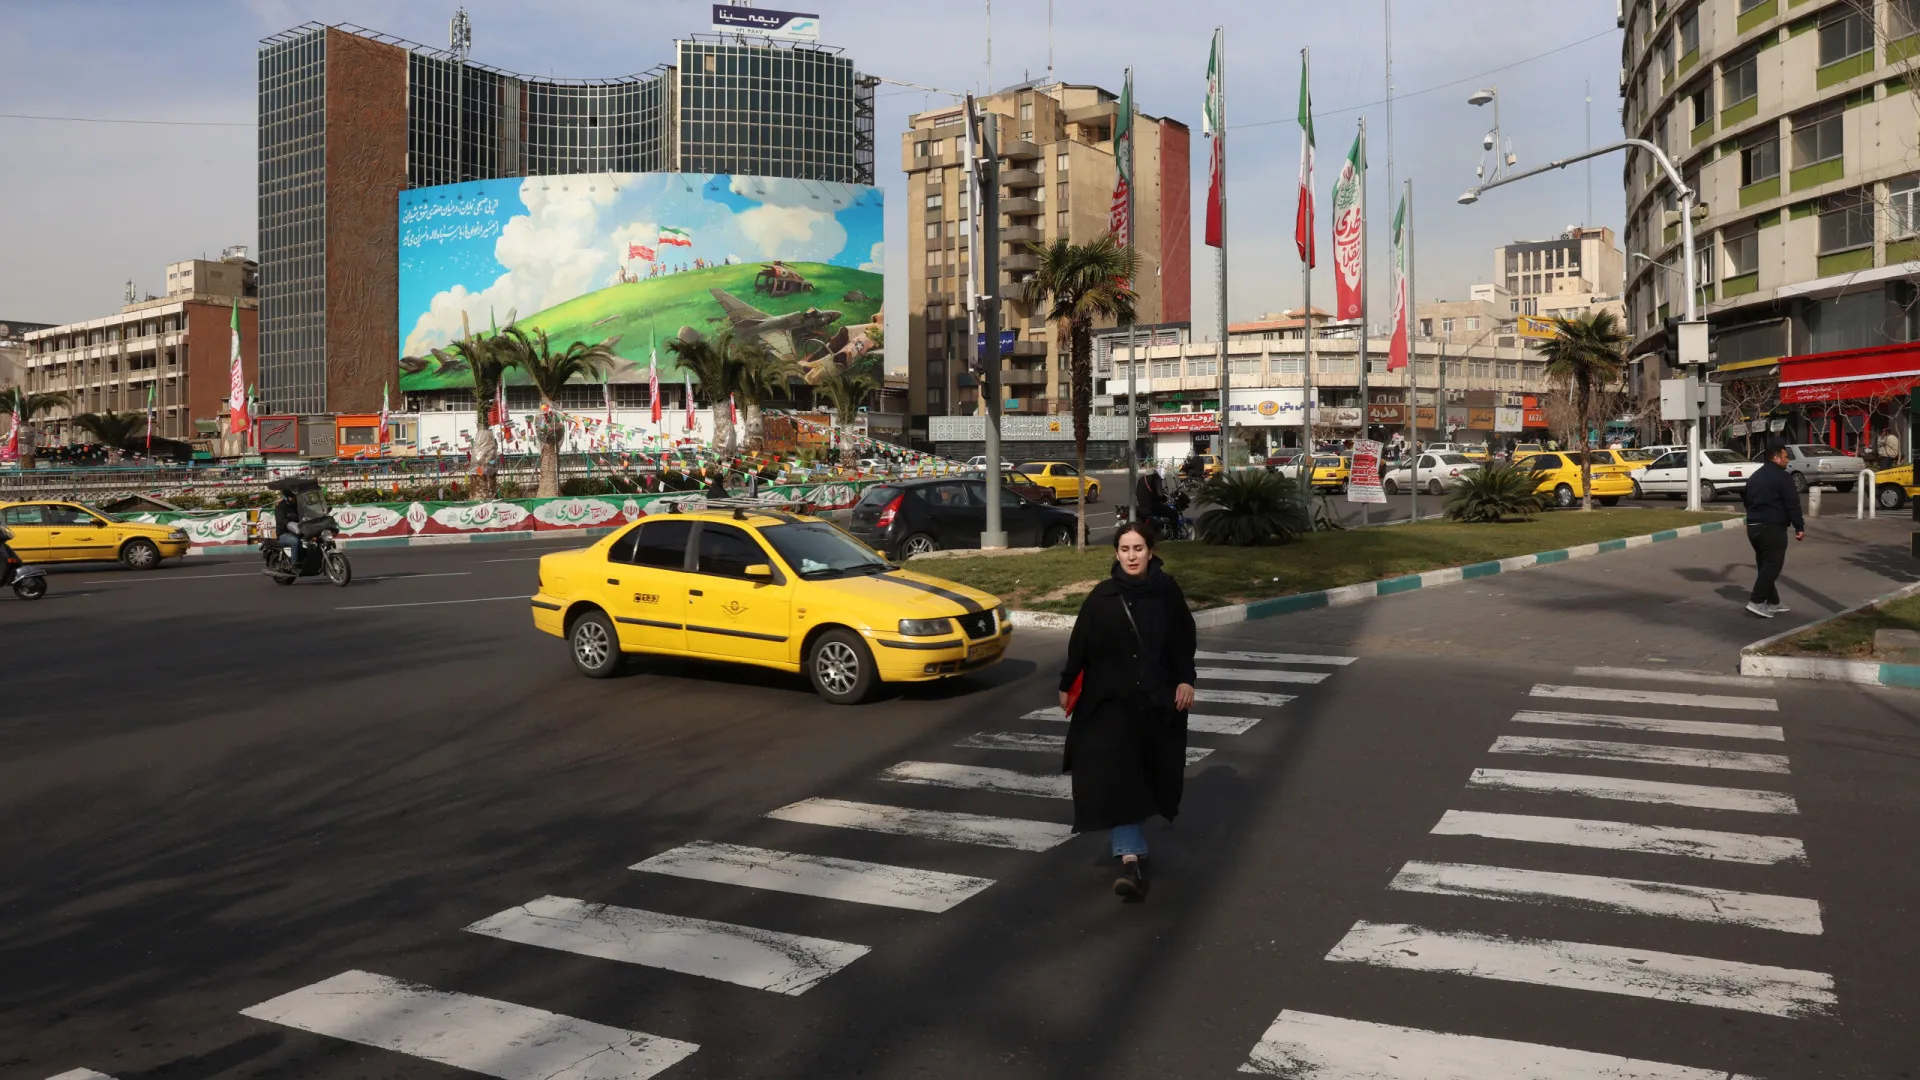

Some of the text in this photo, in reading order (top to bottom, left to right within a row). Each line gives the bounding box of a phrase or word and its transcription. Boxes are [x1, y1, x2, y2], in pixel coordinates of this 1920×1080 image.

[719, 9, 780, 27] بیمه سینا
[1370, 406, 1399, 422] هدیه
